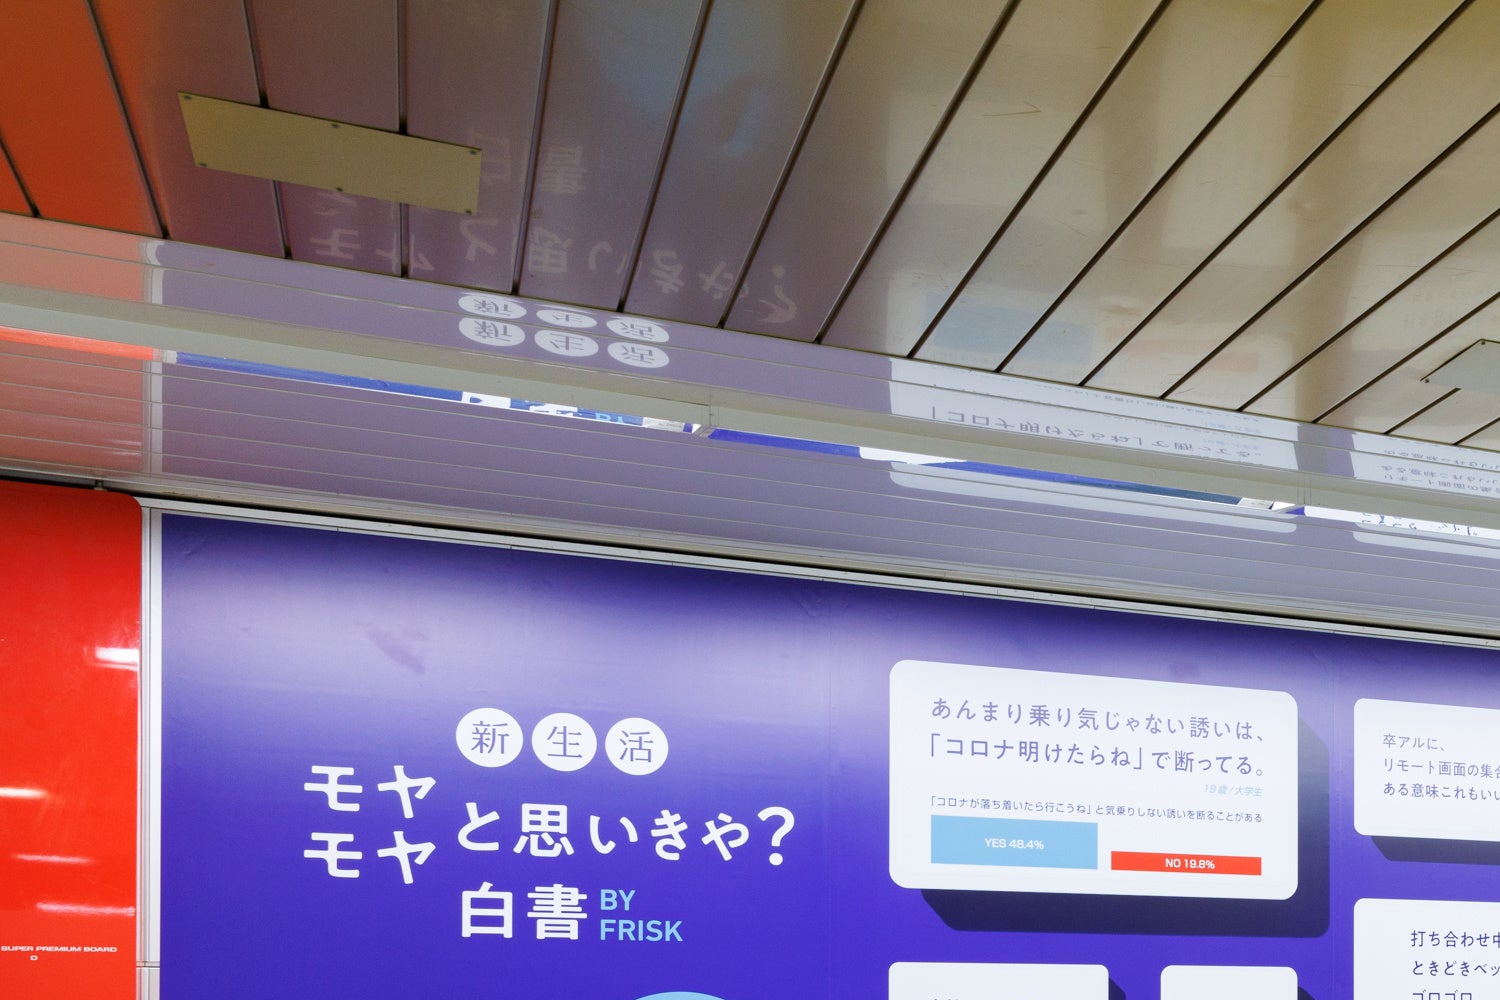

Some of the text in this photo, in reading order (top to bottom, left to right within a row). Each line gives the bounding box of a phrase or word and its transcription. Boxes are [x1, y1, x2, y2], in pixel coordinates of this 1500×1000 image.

[930, 696, 1265, 743] あんまり乗り気じゃない誘いは、
[1381, 732, 1448, 752] 卒アルに、
[929, 731, 1265, 779] 「コロナ明けたらね」で断ってる。
[303, 764, 437, 819] モヤ
[303, 830, 437, 885] モヤ
[457, 802, 796, 866] と思いきや？
[984, 837, 1045, 852] YES 48.4%
[1165, 857, 1216, 871] NO 19.8%
[461, 881, 588, 940] 白書
[600, 888, 636, 912] BY
[600, 919, 684, 942] FRISK
